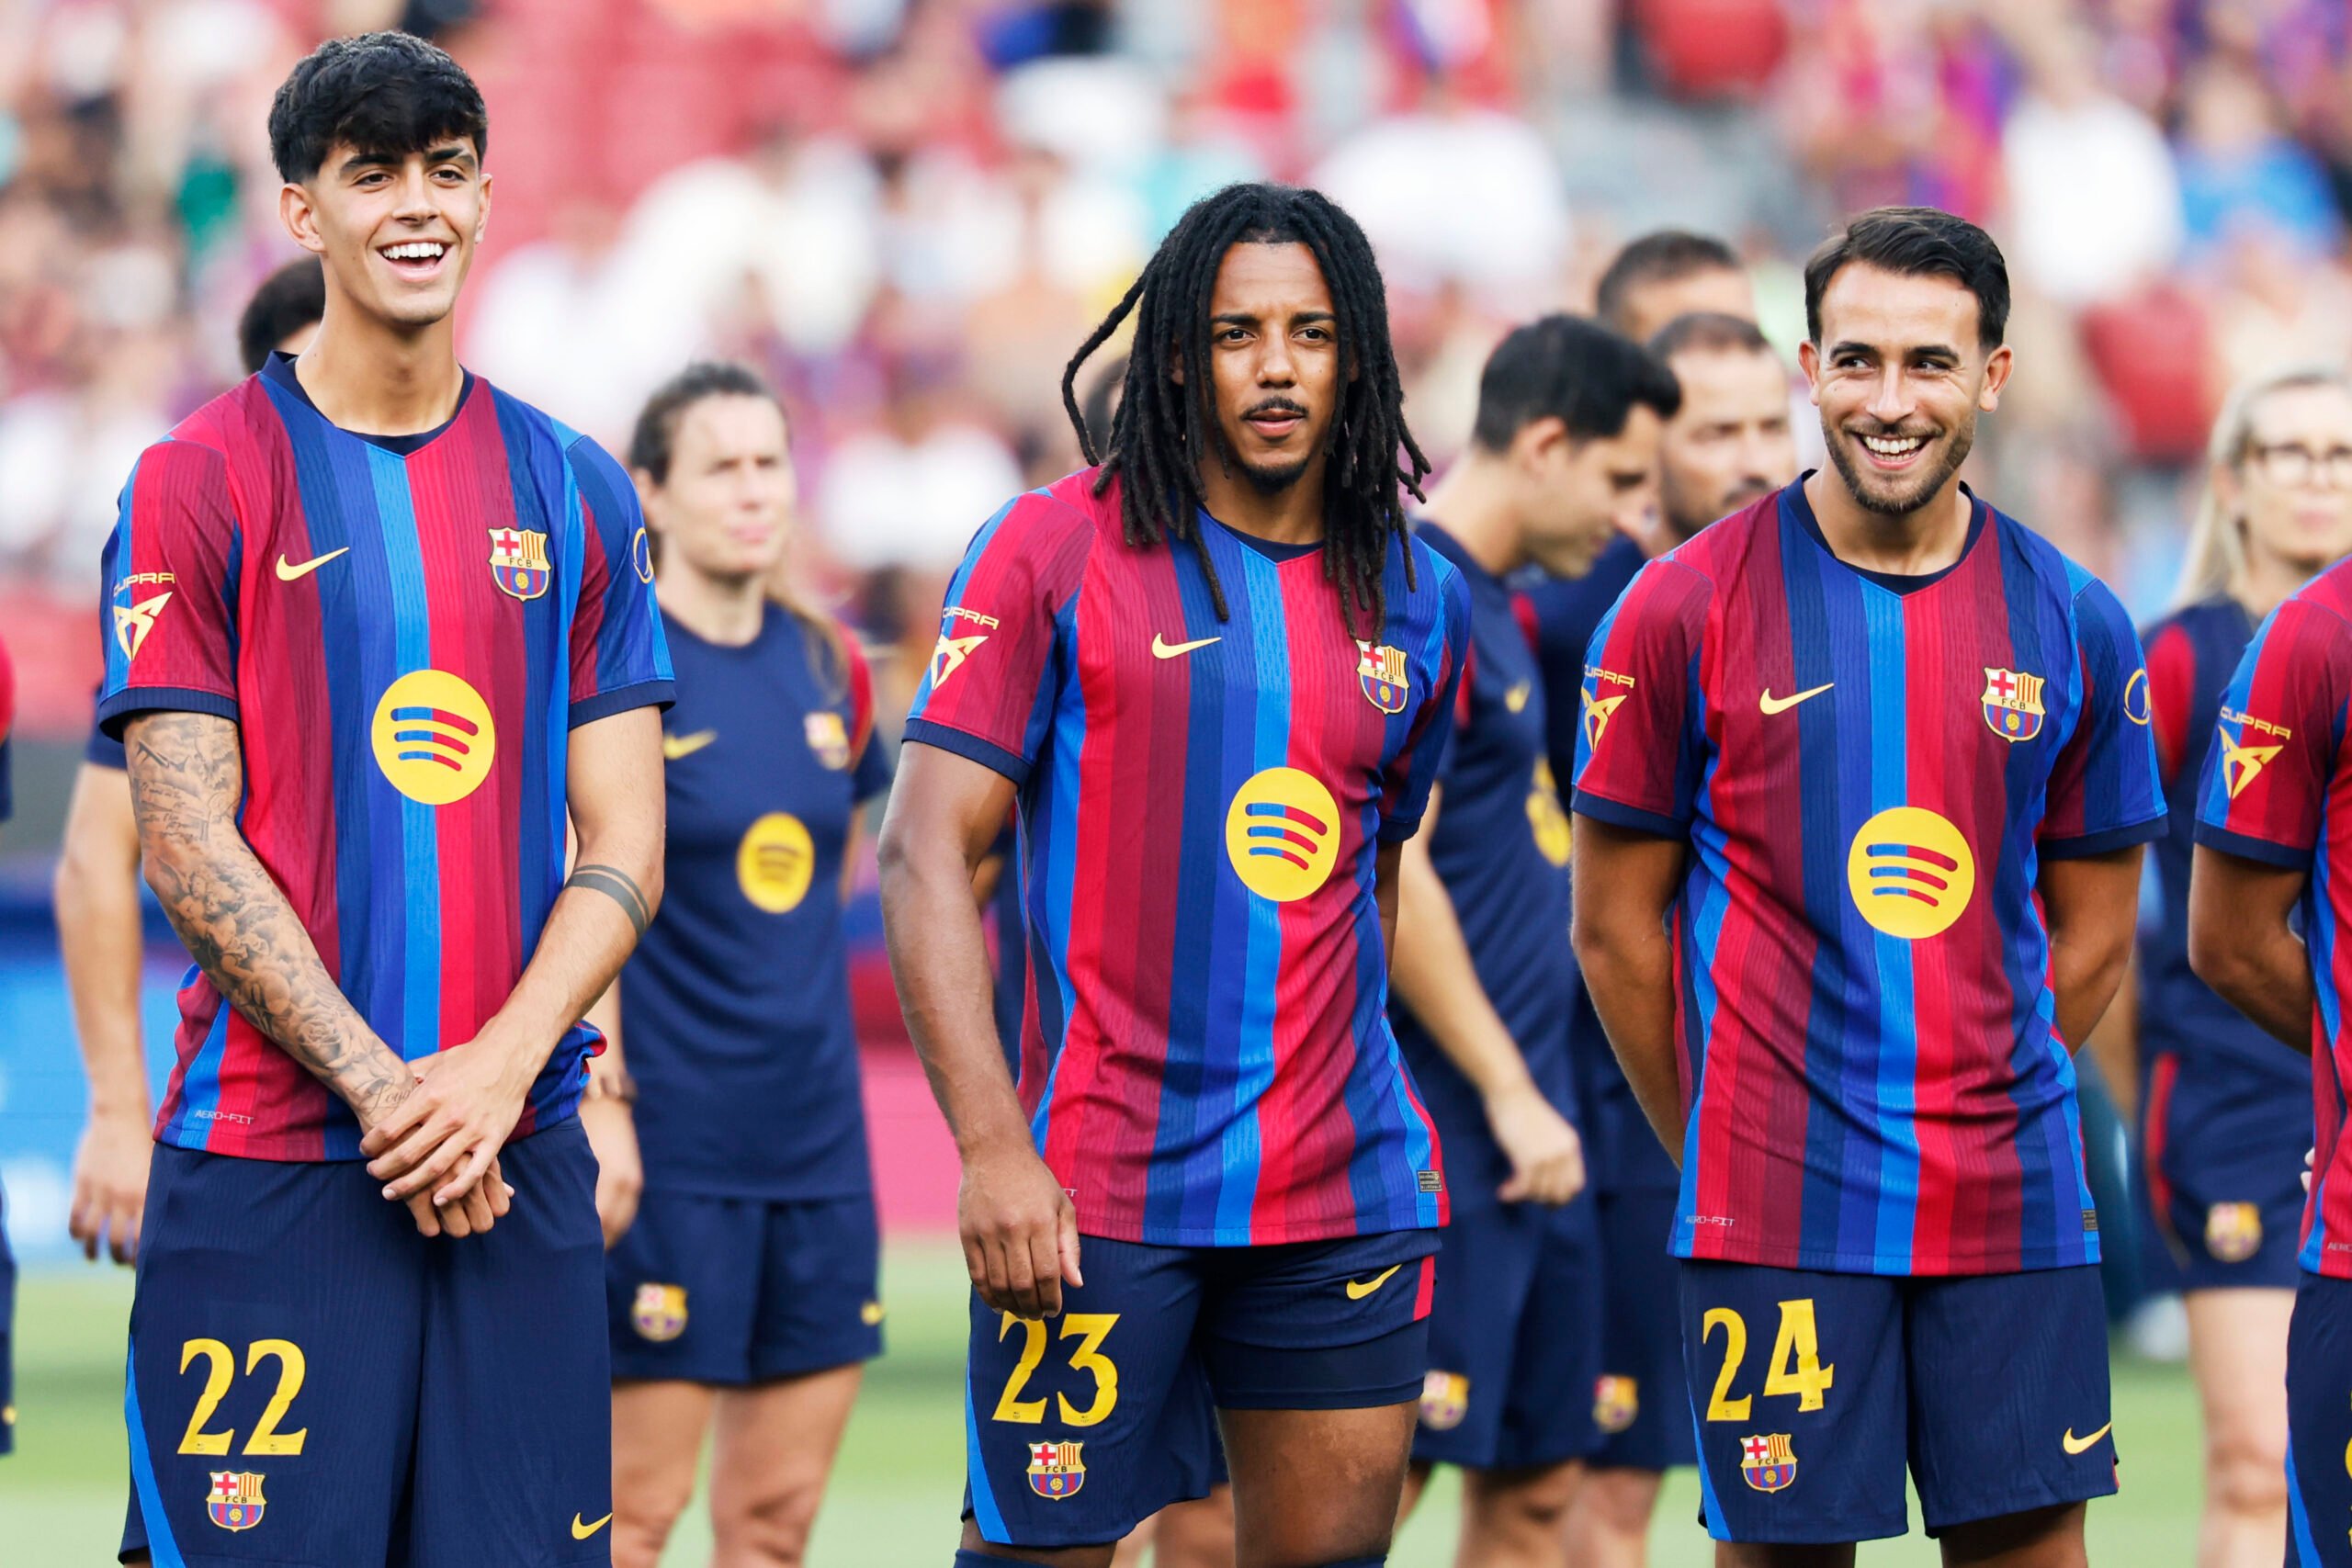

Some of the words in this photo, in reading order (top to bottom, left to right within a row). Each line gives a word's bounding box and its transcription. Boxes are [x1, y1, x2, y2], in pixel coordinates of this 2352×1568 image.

[509, 557, 533, 568] FCB
[942, 606, 1000, 630] CUPRA
[1374, 670, 1395, 683] FCB
[2001, 698, 2026, 710] FCB
[2220, 705, 2291, 740] CUPRA
[194, 1110, 254, 1125] AERO-FIT
[1702, 1298, 1835, 1423] 24
[991, 1310, 1121, 1427] 23
[177, 1337, 308, 1457] 22
[1045, 1465, 1068, 1473] FCB
[1758, 1457, 1780, 1467] FCB
[225, 1495, 248, 1504] FCB
